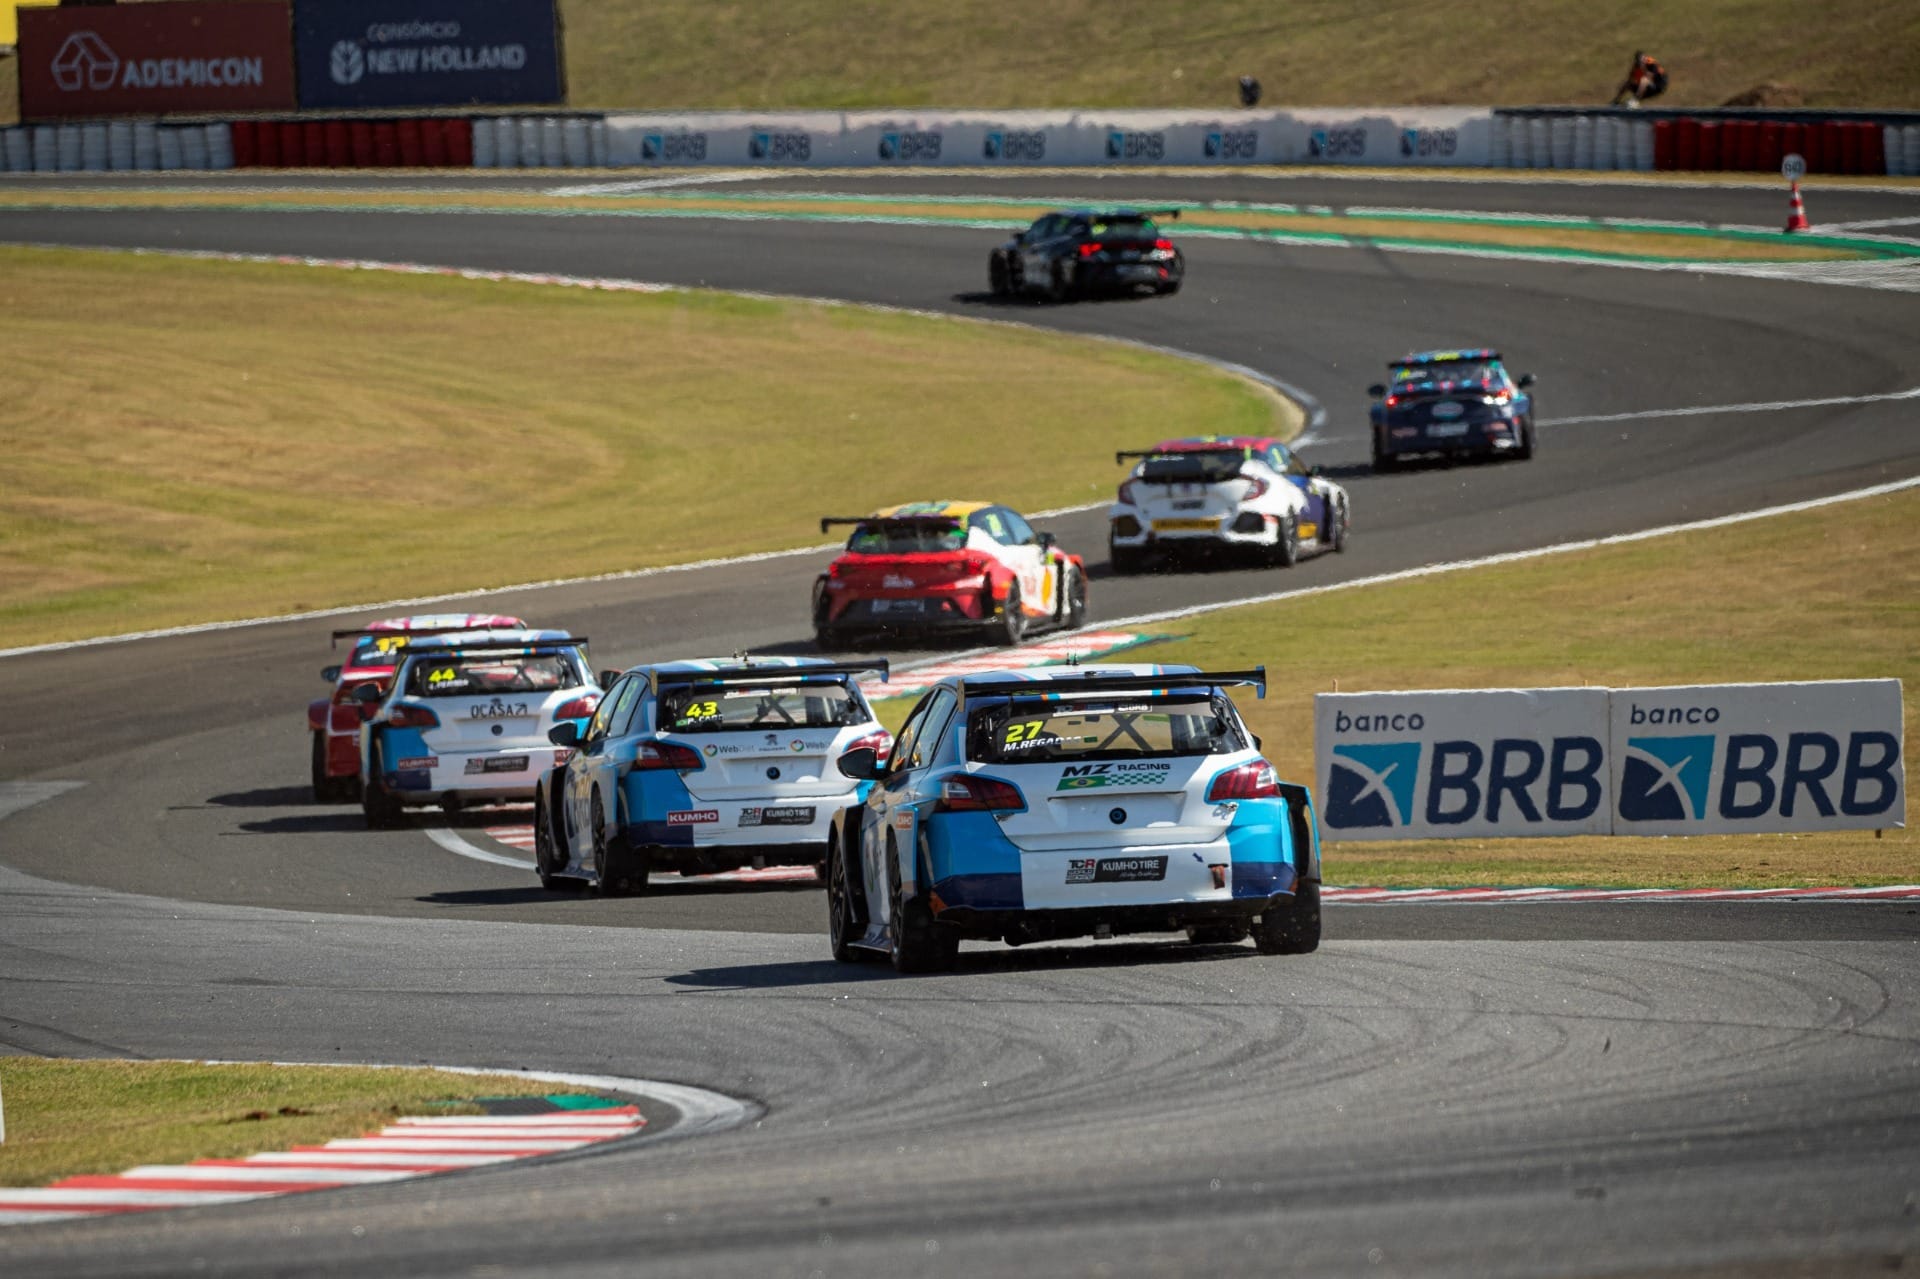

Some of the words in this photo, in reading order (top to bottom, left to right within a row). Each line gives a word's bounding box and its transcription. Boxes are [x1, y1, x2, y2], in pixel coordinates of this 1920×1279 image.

[367, 48, 419, 73] NEW
[421, 44, 526, 72] HOLLAND
[122, 56, 263, 87] ADEMICON
[428, 668, 456, 682] 44
[471, 703, 513, 719] OCASA
[686, 701, 718, 717] 43
[1630, 704, 1720, 725] banco
[1335, 710, 1425, 733] banco
[1005, 720, 1043, 743] 27
[1062, 763, 1114, 778] MZ
[1117, 763, 1171, 771] RACING
[1718, 731, 1900, 818] BRB
[1425, 737, 1603, 825] BRB
[669, 811, 718, 822] KUMHO
[1068, 859, 1095, 869] TCR
[1102, 860, 1138, 871] KUMHO
[1138, 859, 1160, 869] TIRE
